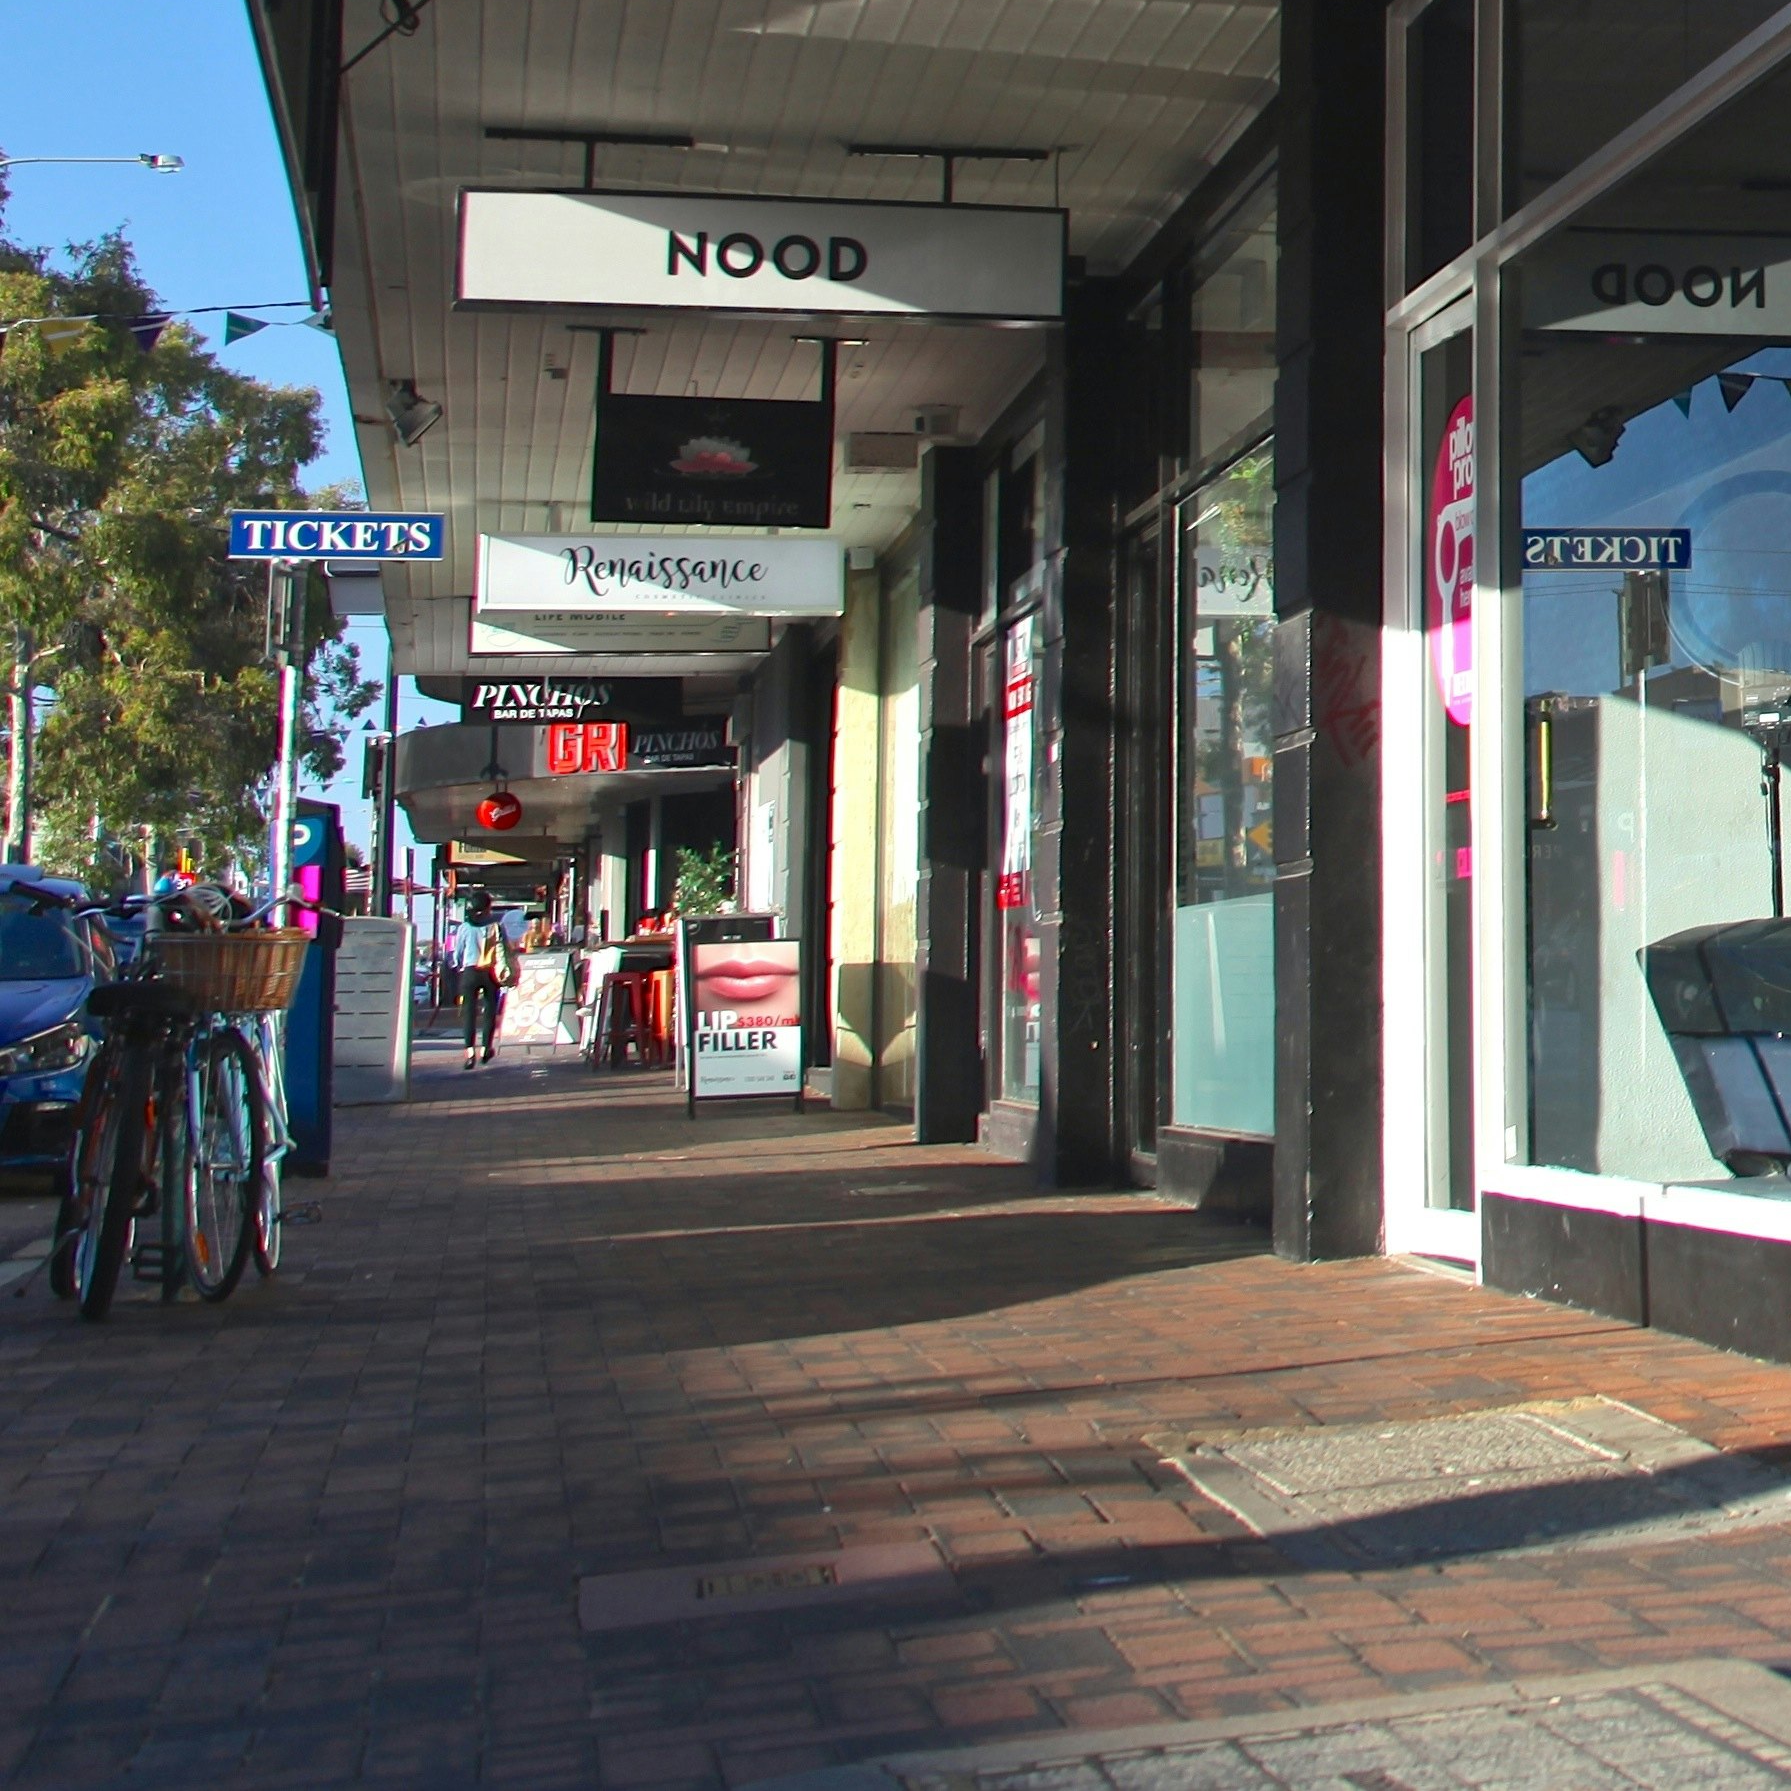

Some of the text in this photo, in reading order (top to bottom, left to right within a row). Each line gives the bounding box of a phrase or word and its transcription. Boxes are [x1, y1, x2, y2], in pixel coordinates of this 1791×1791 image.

[667, 230, 869, 283] NOOD
[243, 519, 431, 553] TICKETS
[558, 545, 769, 597] Renaissance
[472, 682, 613, 709] PINCHOS
[494, 708, 574, 720] BAR DE TAPAS
[634, 730, 720, 755] PINCHOS
[698, 1010, 738, 1031] LIP
[699, 1030, 778, 1052] FILLER
